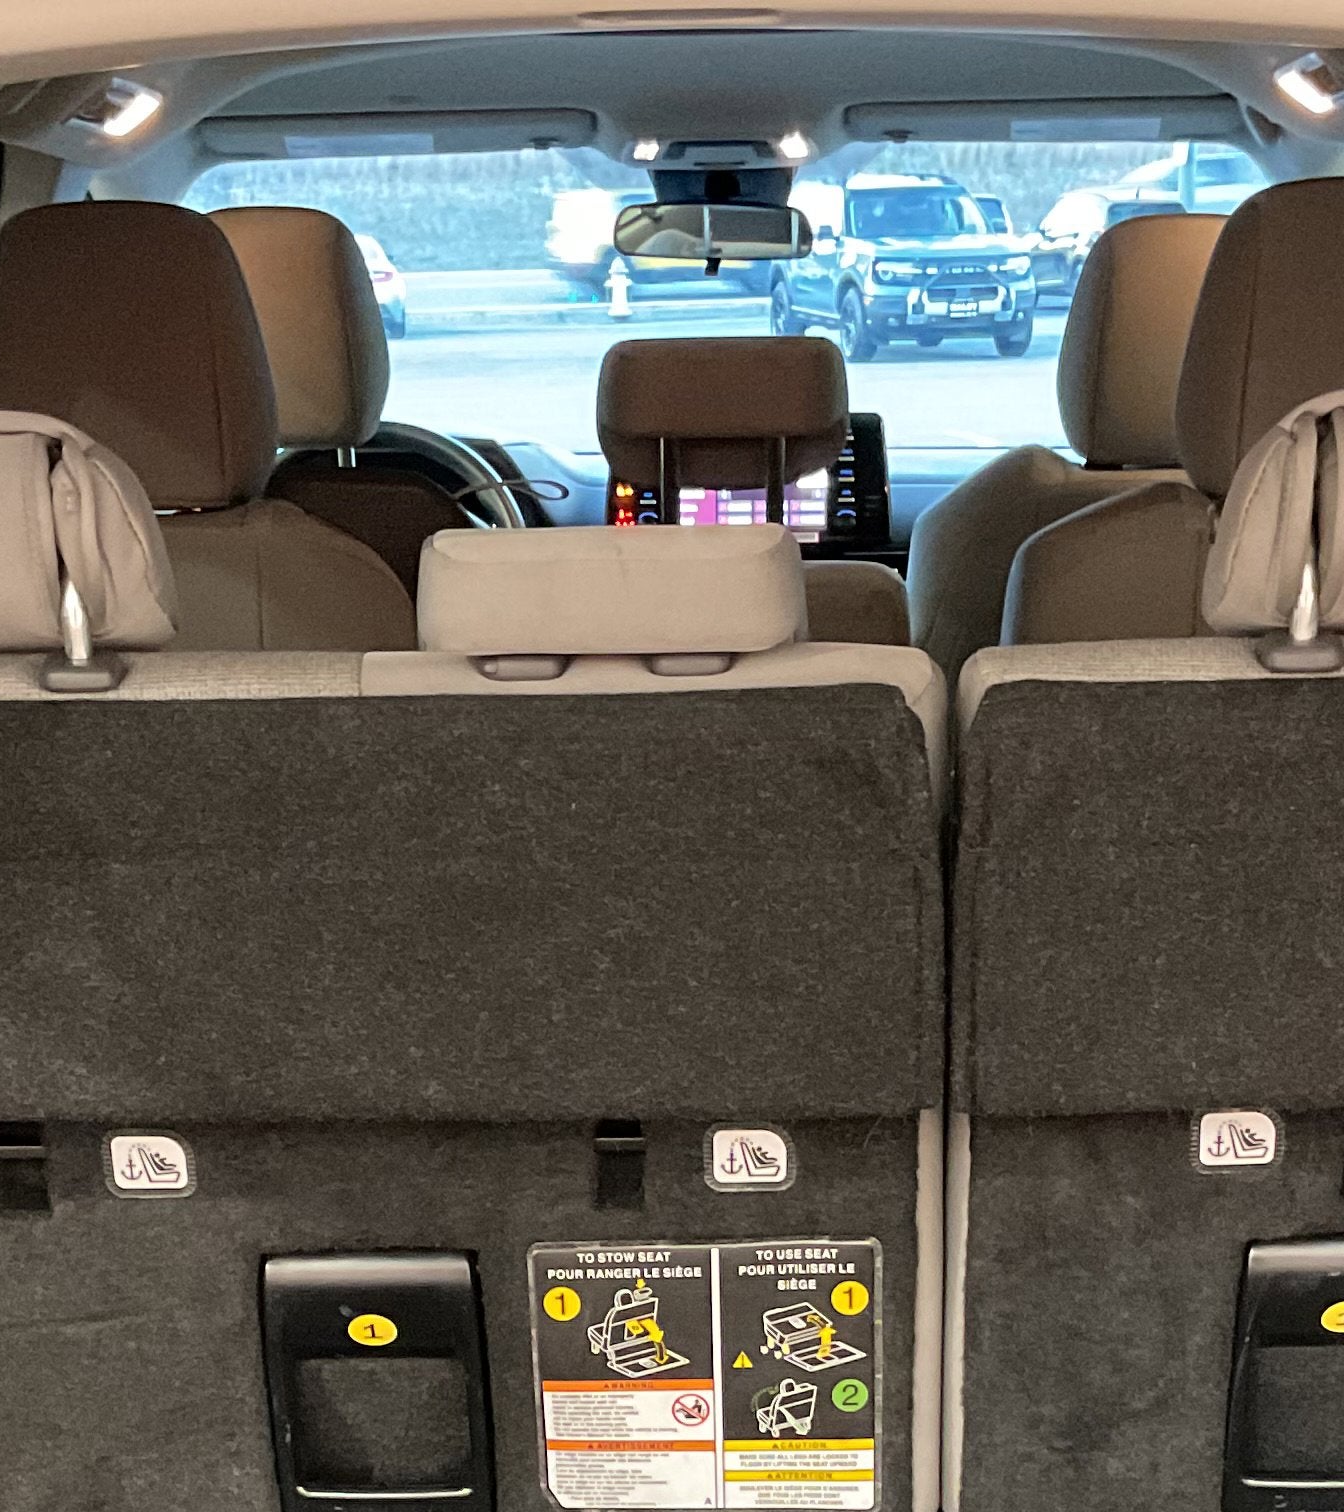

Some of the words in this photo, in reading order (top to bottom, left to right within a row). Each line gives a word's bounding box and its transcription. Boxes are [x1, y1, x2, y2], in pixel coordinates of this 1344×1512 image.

[576, 1252, 595, 1264] TO
[597, 1252, 635, 1263] STOW
[637, 1251, 672, 1262] SEAT
[755, 1249, 773, 1261] TO
[776, 1249, 802, 1260] USE
[804, 1248, 839, 1259] SEAT
[547, 1268, 584, 1279] POUR
[586, 1267, 641, 1279] RANGER
[643, 1267, 660, 1278] LE
[662, 1265, 702, 1278] SIÈGE
[738, 1264, 775, 1276] POUR
[777, 1263, 836, 1275] UTILISER
[838, 1263, 856, 1274] LE
[777, 1277, 817, 1290] SIÈGE
[555, 1292, 567, 1315] 1
[844, 1286, 856, 1309] 1
[362, 1323, 384, 1340] 1
[841, 1384, 859, 1406] 2
[779, 1441, 827, 1449] CAUTION
